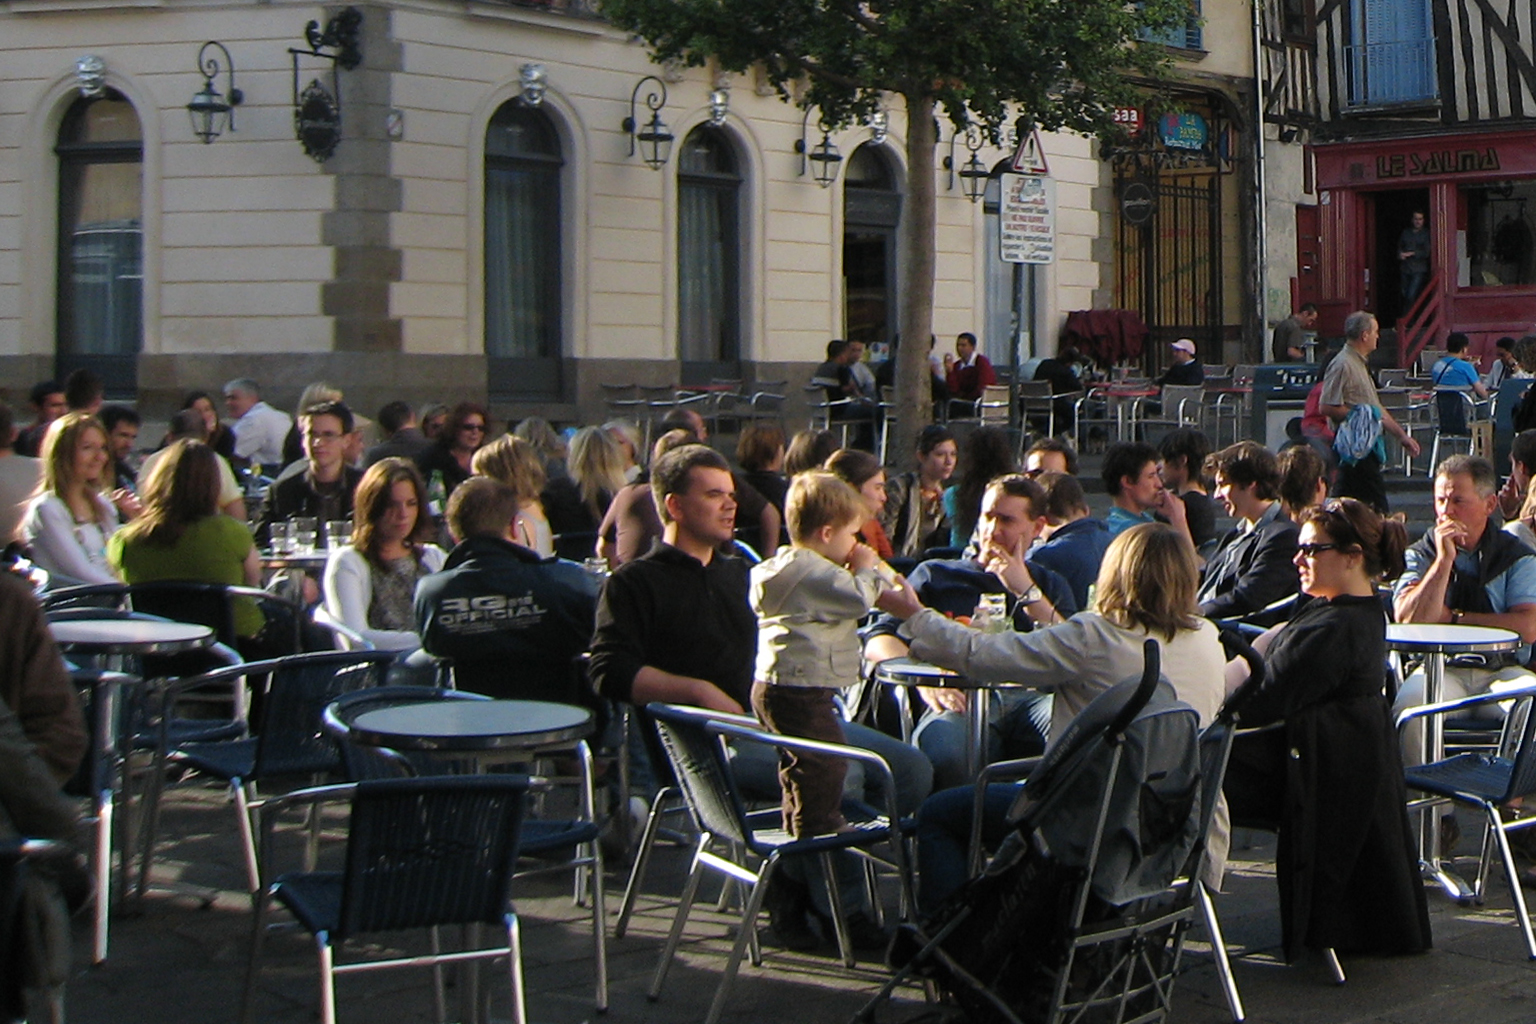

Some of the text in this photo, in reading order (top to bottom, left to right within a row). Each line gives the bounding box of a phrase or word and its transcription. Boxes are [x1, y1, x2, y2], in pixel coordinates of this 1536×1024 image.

[1376, 147, 1501, 178] LE SALMA
[438, 604, 549, 625] OFFICIAL
